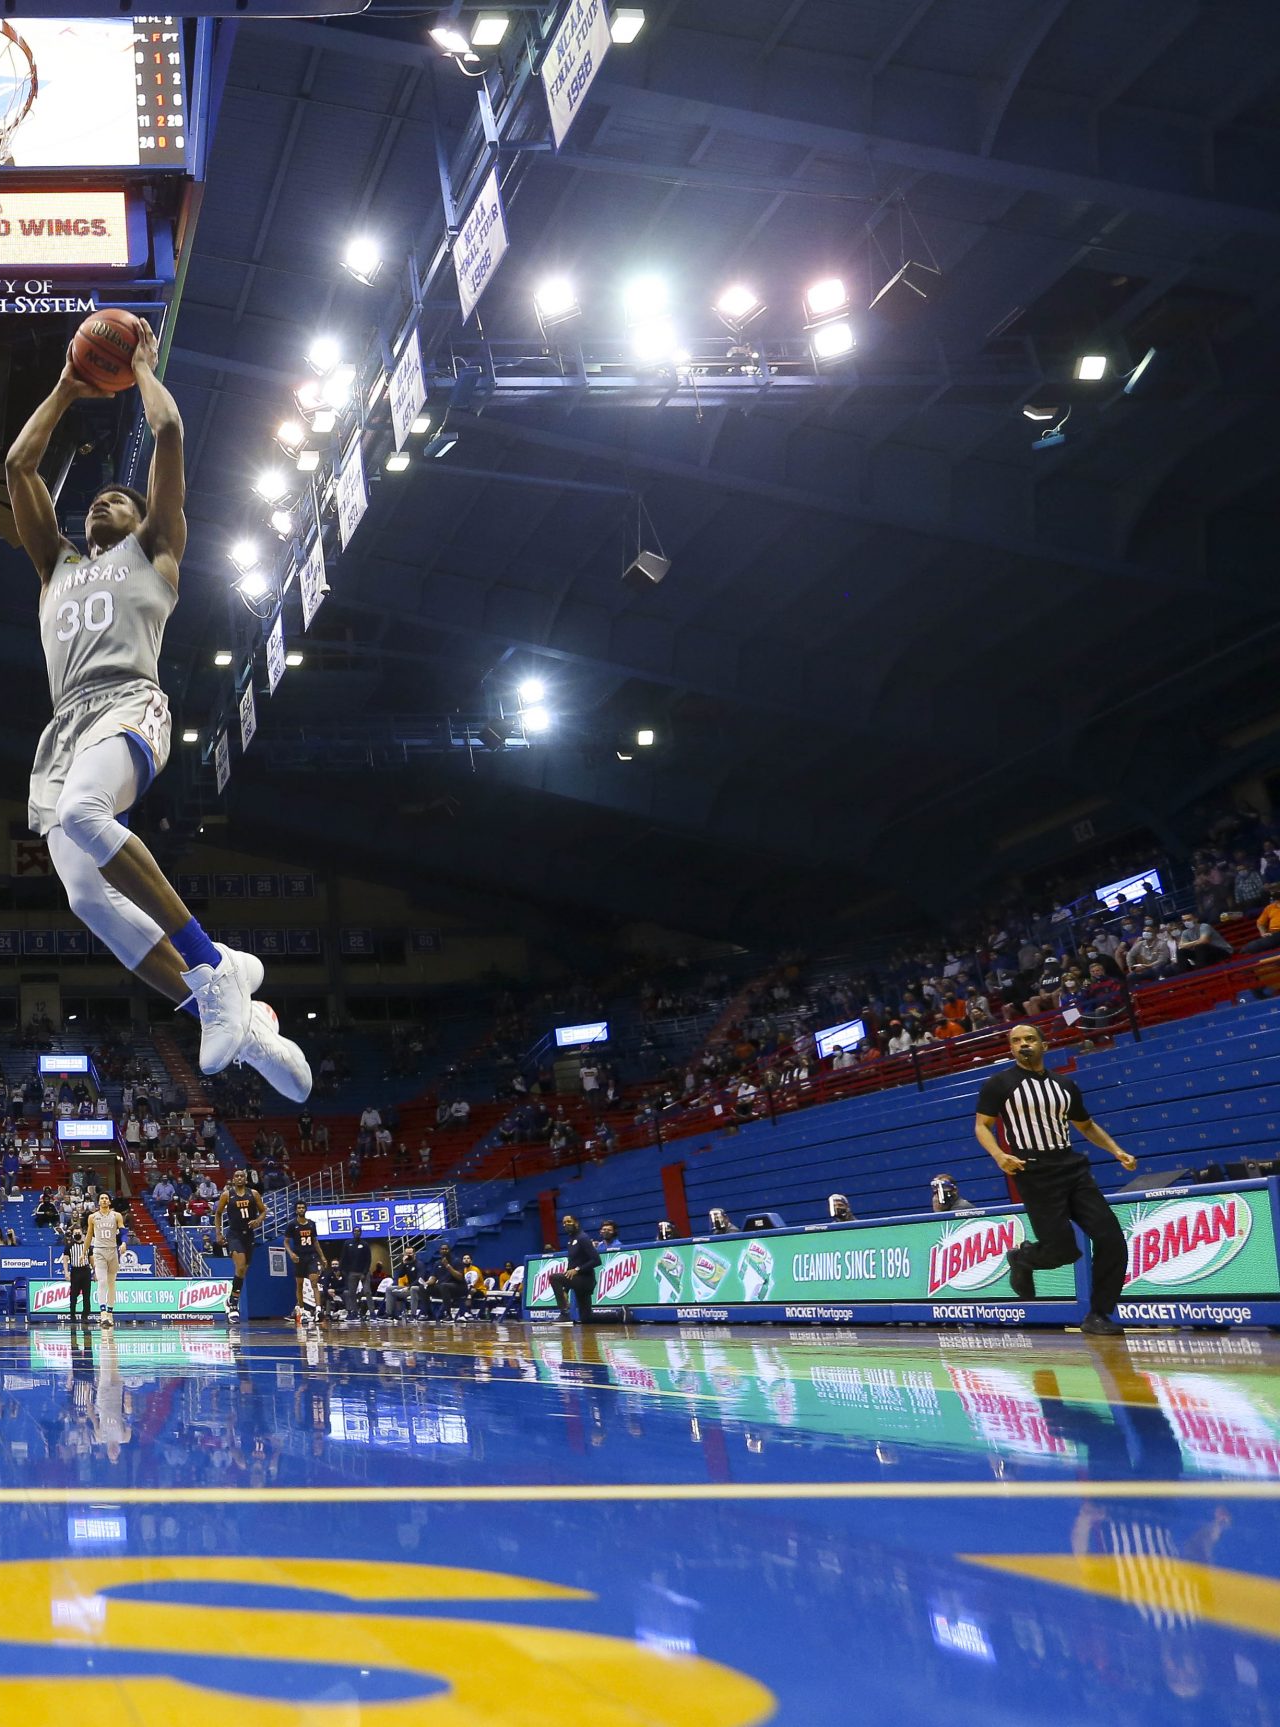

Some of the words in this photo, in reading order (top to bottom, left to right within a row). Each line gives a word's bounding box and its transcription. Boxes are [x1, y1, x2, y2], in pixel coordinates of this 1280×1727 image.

[152, 33, 161, 42] F
[162, 33, 179, 42] PT
[556, 0, 584, 64] NCAA
[154, 52, 161, 64] 1
[549, 51, 575, 106] FINAL
[576, 1, 599, 51] FOUR
[155, 73, 163, 85] 1
[567, 49, 593, 112] 1988
[157, 116, 166, 127] 2
[464, 200, 487, 251] NCAA
[459, 243, 480, 282] FINAL
[479, 202, 500, 246] FOUR
[472, 247, 491, 293] 1986
[24, 279, 53, 295] OF
[13, 296, 98, 313] SYSTEM
[52, 564, 130, 601] KANSAS
[56, 590, 115, 643] 30
[240, 1208, 249, 1219] 11
[100, 1229, 111, 1239] 10
[338, 1220, 350, 1231] 31
[300, 1236, 312, 1246] 24
[792, 1250, 842, 1282] CLEANING
[844, 1249, 877, 1280] SINCE
[879, 1247, 911, 1279] 1896
[929, 1220, 1015, 1294] LIBMAN
[597, 1255, 638, 1302] LIBMAN
[131, 1291, 152, 1303] SINCE
[155, 1291, 174, 1303] 1896
[179, 1283, 229, 1310] LIBMAN
[186, 1313, 214, 1321] Mortgage
[677, 1309, 701, 1318] ROCKET
[701, 1309, 729, 1320] Mortgage
[785, 1307, 816, 1318] ROCKET
[817, 1308, 853, 1321] Mortgage
[932, 1306, 975, 1319] ROCKET
[976, 1306, 1026, 1322] Mortgage
[1117, 1304, 1177, 1320] ROCKET
[1179, 1304, 1252, 1322] Mortgage
